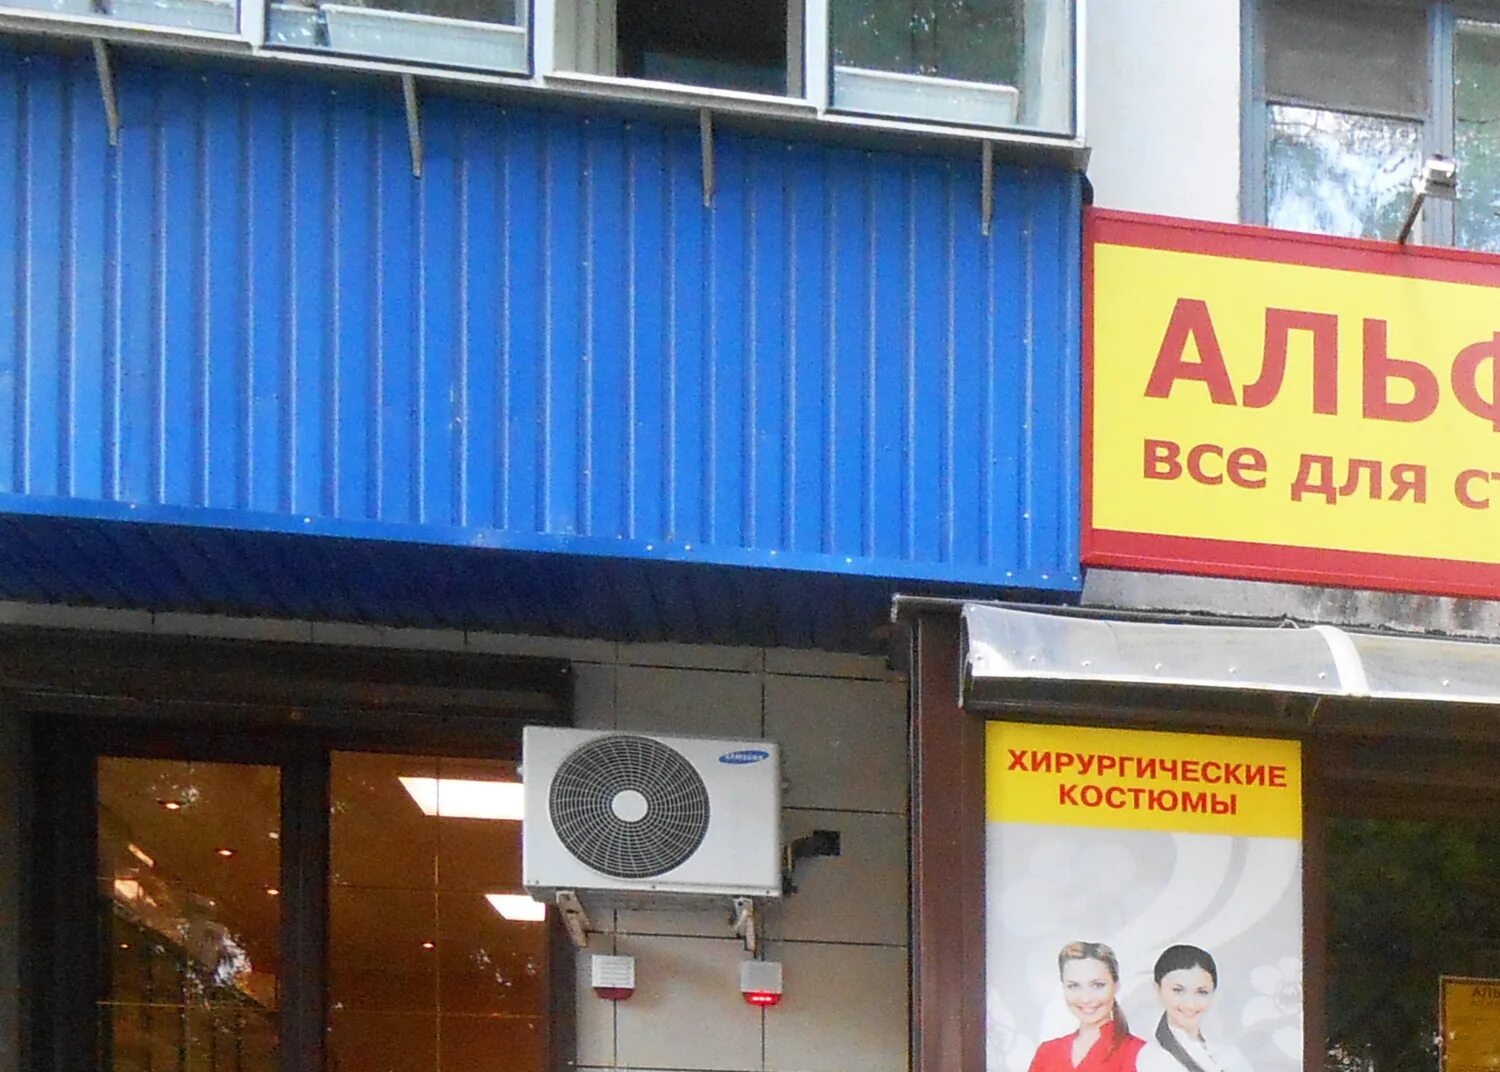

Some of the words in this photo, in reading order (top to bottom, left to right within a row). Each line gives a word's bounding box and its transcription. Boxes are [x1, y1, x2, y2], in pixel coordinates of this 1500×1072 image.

[1143, 438, 1268, 489] все
[1290, 453, 1427, 505] для
[1007, 749, 1288, 788] ХИРУРГИЧЕСКИЕ
[1059, 784, 1237, 815] КОСТЮМЫ
